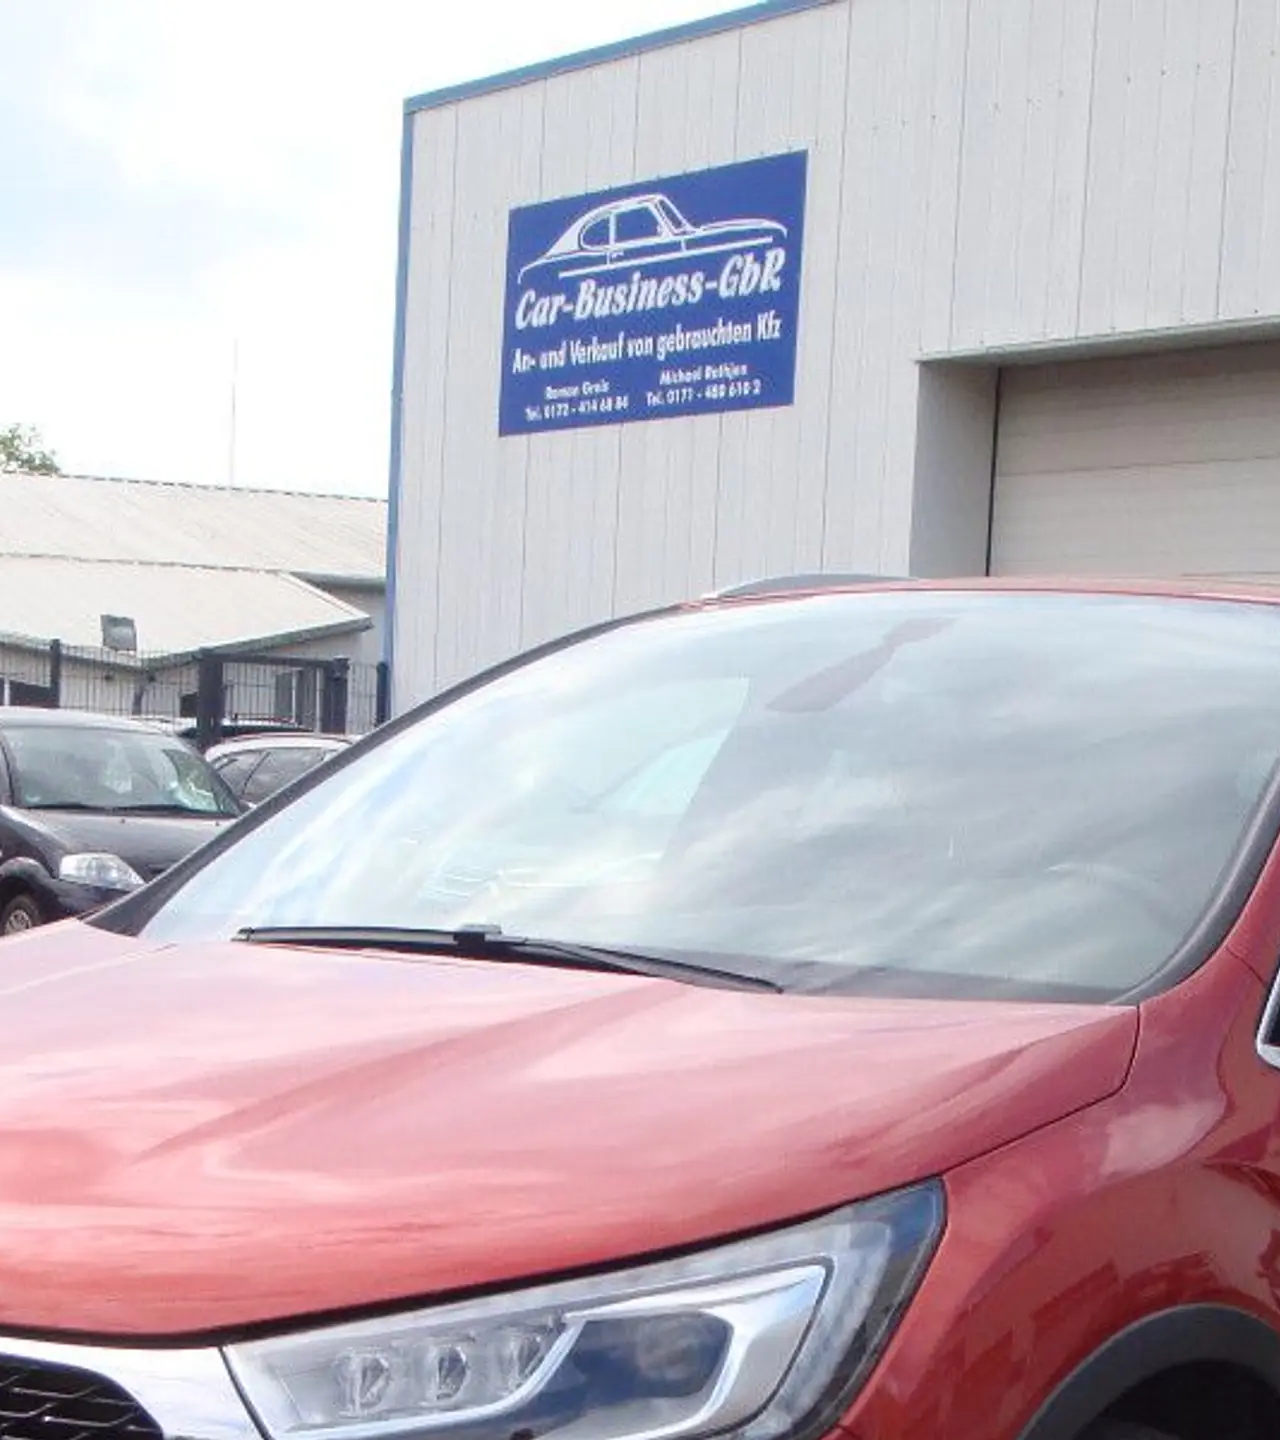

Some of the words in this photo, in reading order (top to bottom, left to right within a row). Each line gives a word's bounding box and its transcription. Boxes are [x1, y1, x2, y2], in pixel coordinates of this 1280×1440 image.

[515, 247, 786, 330] Car-Business-GbR
[512, 348, 536, 374] An-
[540, 339, 565, 369] und
[570, 331, 623, 366] Verkauf
[627, 337, 654, 358] von
[656, 318, 752, 361] gebrauchten
[756, 310, 782, 341] Kfz
